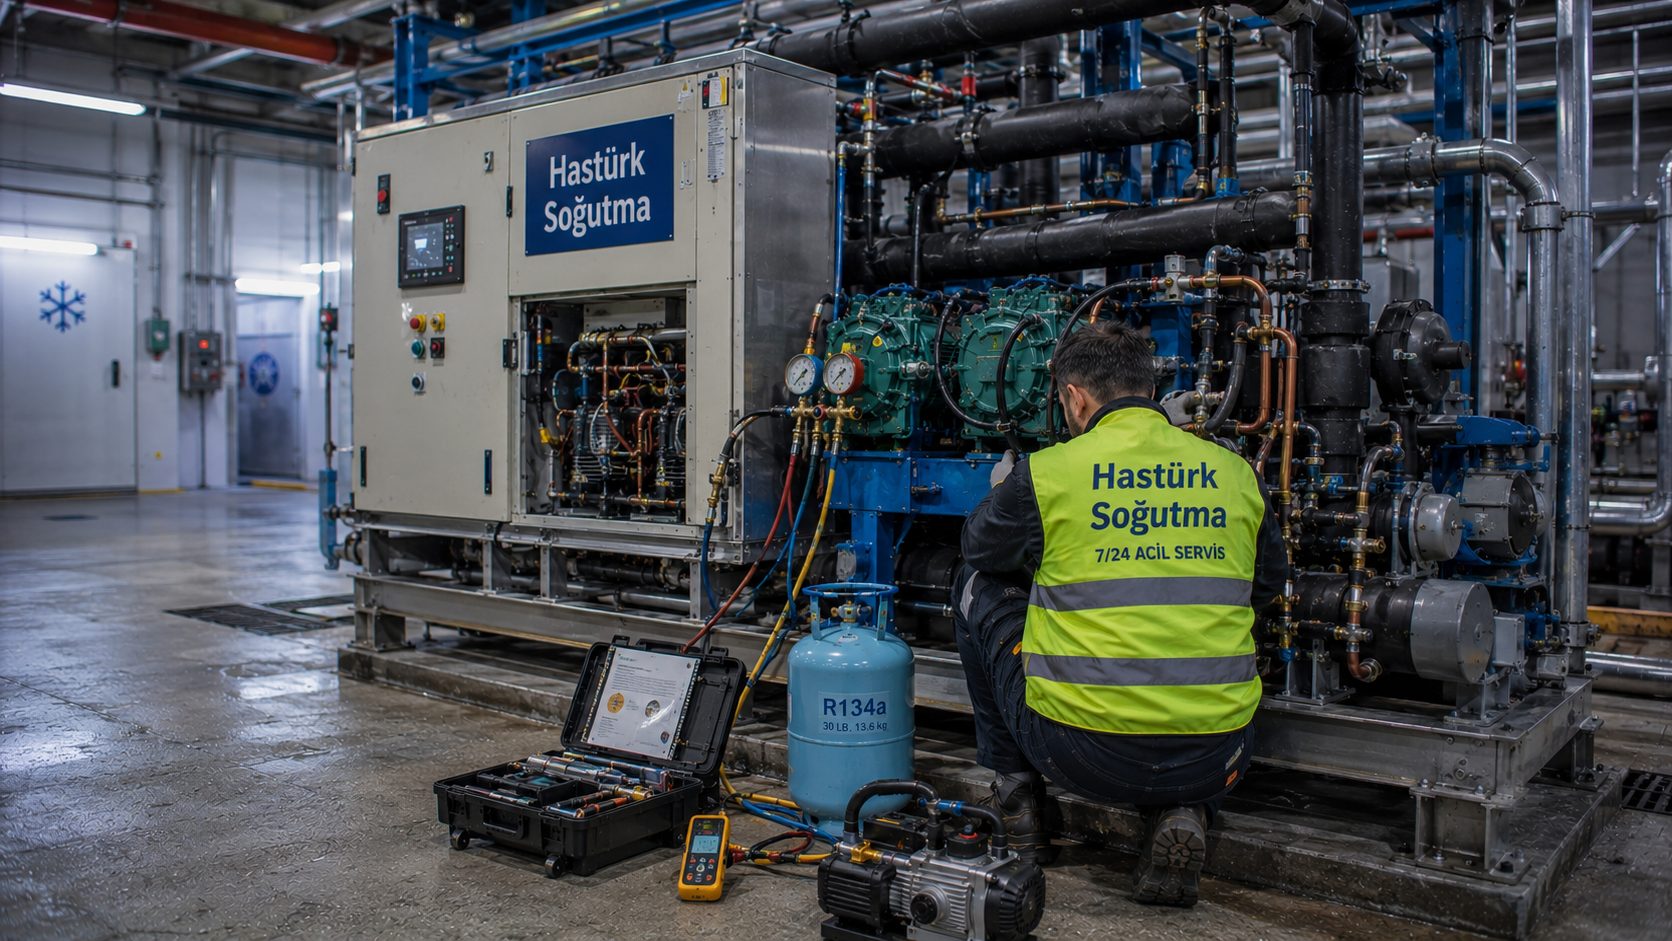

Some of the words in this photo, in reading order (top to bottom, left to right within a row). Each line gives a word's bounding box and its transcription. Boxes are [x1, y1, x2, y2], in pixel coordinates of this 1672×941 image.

[549, 141, 646, 189] Hastürk
[543, 194, 651, 238] Soğutma
[1092, 461, 1219, 490] Hastürk
[1090, 499, 1227, 536] Soğutma
[1095, 547, 1131, 563] 7/24
[1135, 542, 1170, 561] ACİL
[1174, 542, 1226, 560] SERVİS
[823, 697, 887, 717] R134a
[823, 721, 834, 731] 30
[836, 722, 852, 732] LB.
[876, 721, 888, 731] kg
